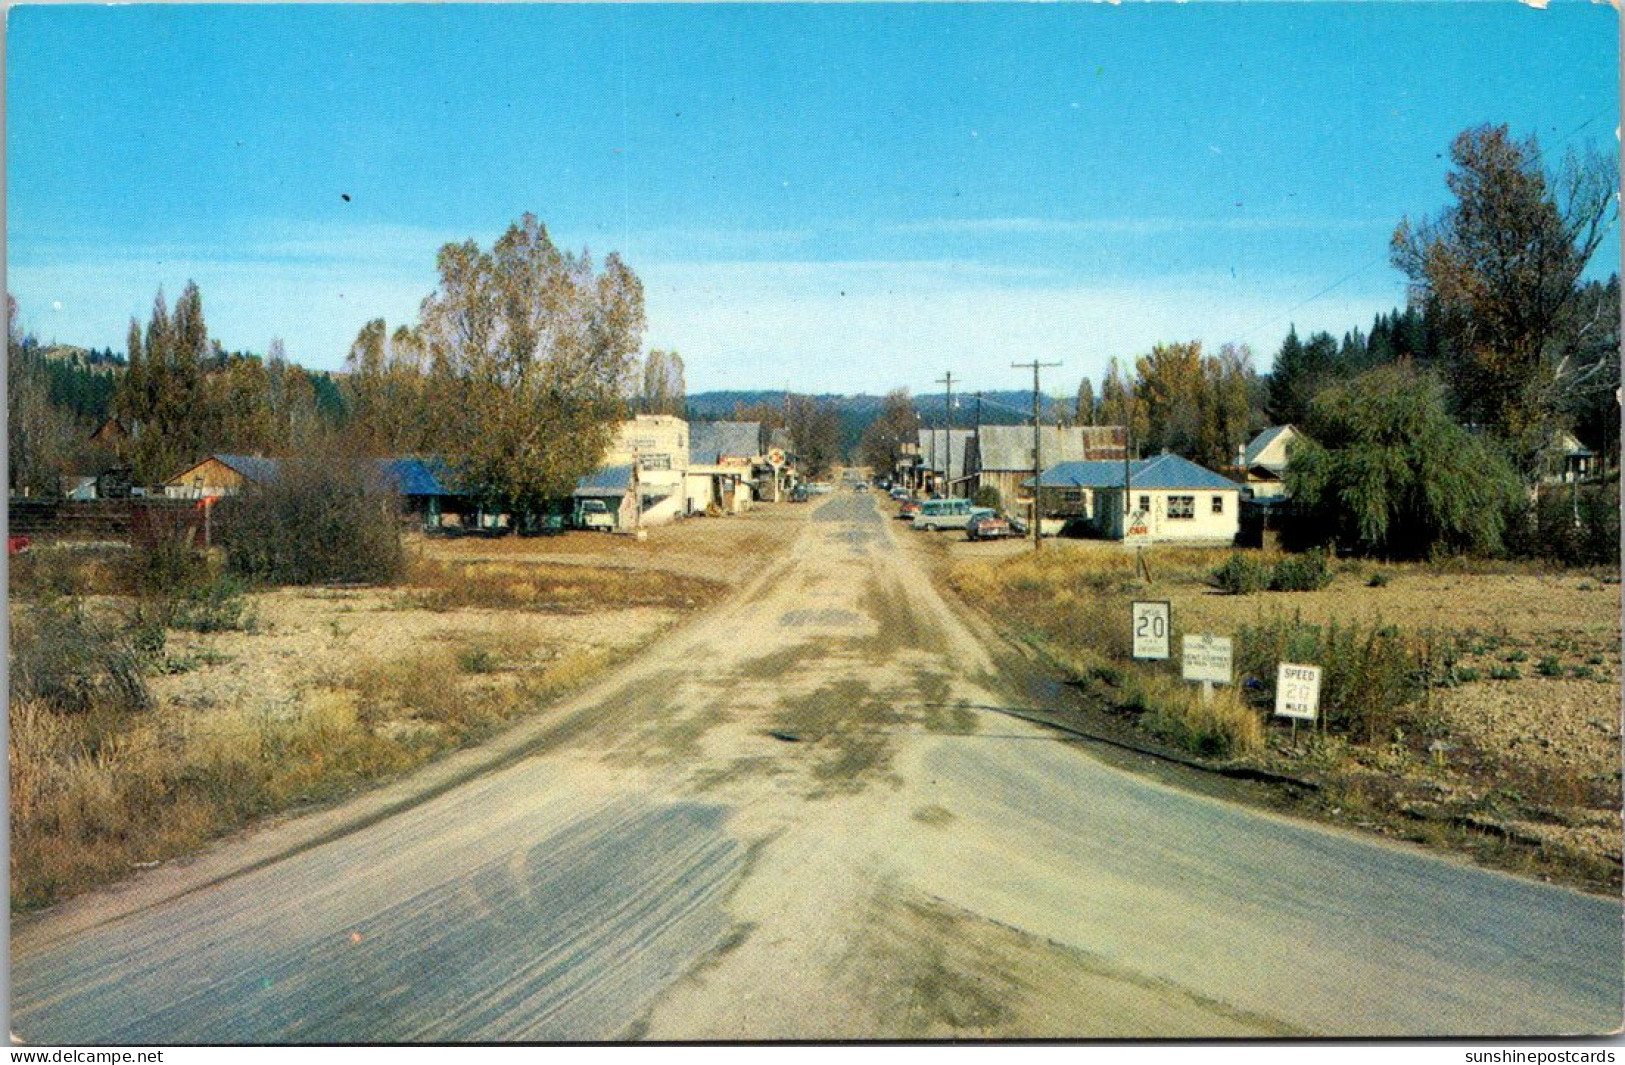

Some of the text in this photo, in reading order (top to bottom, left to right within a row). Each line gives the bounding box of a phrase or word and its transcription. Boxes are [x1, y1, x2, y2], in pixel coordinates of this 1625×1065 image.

[1136, 616, 1165, 638] 20
[1284, 668, 1315, 681] SPEED
[1285, 702, 1308, 713] MILES
